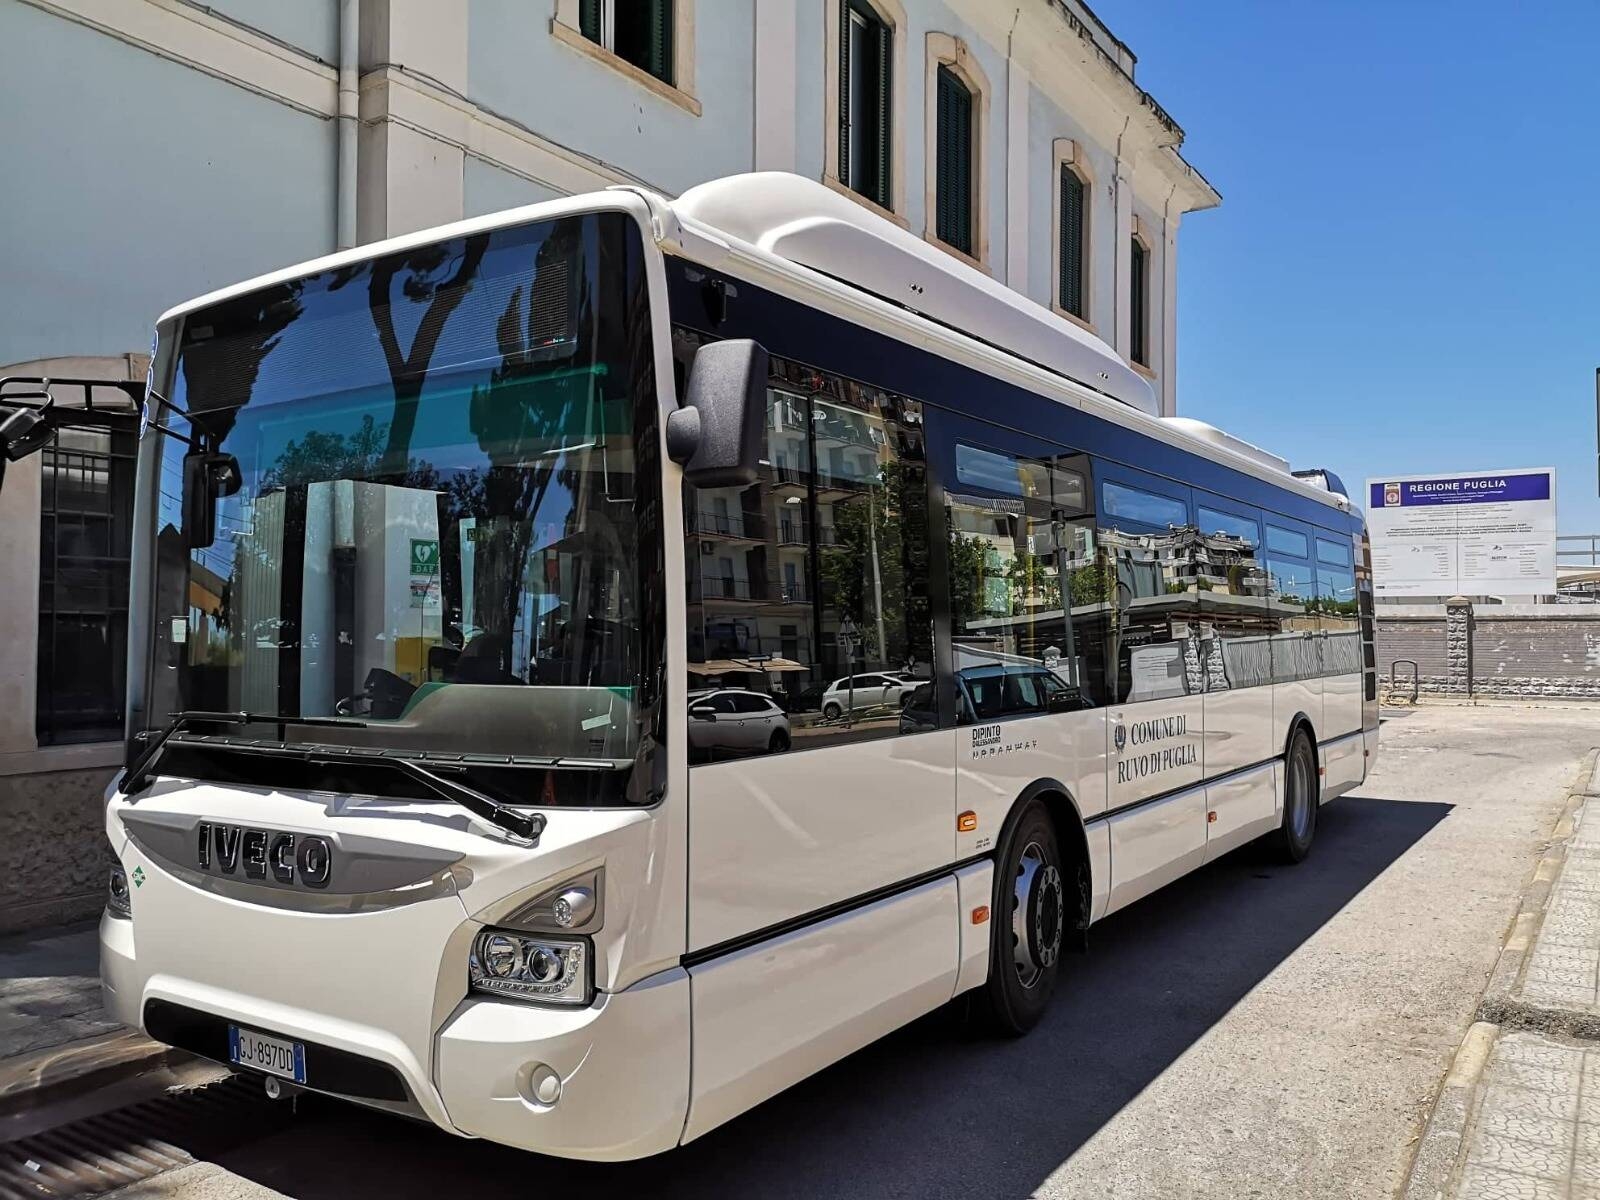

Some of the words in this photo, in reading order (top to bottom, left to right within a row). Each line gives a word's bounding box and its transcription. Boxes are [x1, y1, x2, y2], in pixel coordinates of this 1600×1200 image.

[1409, 482, 1460, 493] REGIONE
[1463, 480, 1506, 490] PUGLIA
[972, 725, 1001, 740] DIPINTO
[1131, 717, 1175, 745] COMUNE
[1176, 714, 1186, 736] DI
[1117, 755, 1149, 784] RUVO
[1150, 751, 1161, 775] DI
[1163, 744, 1197, 771] PUGLIA
[198, 824, 332, 890] IVECO
